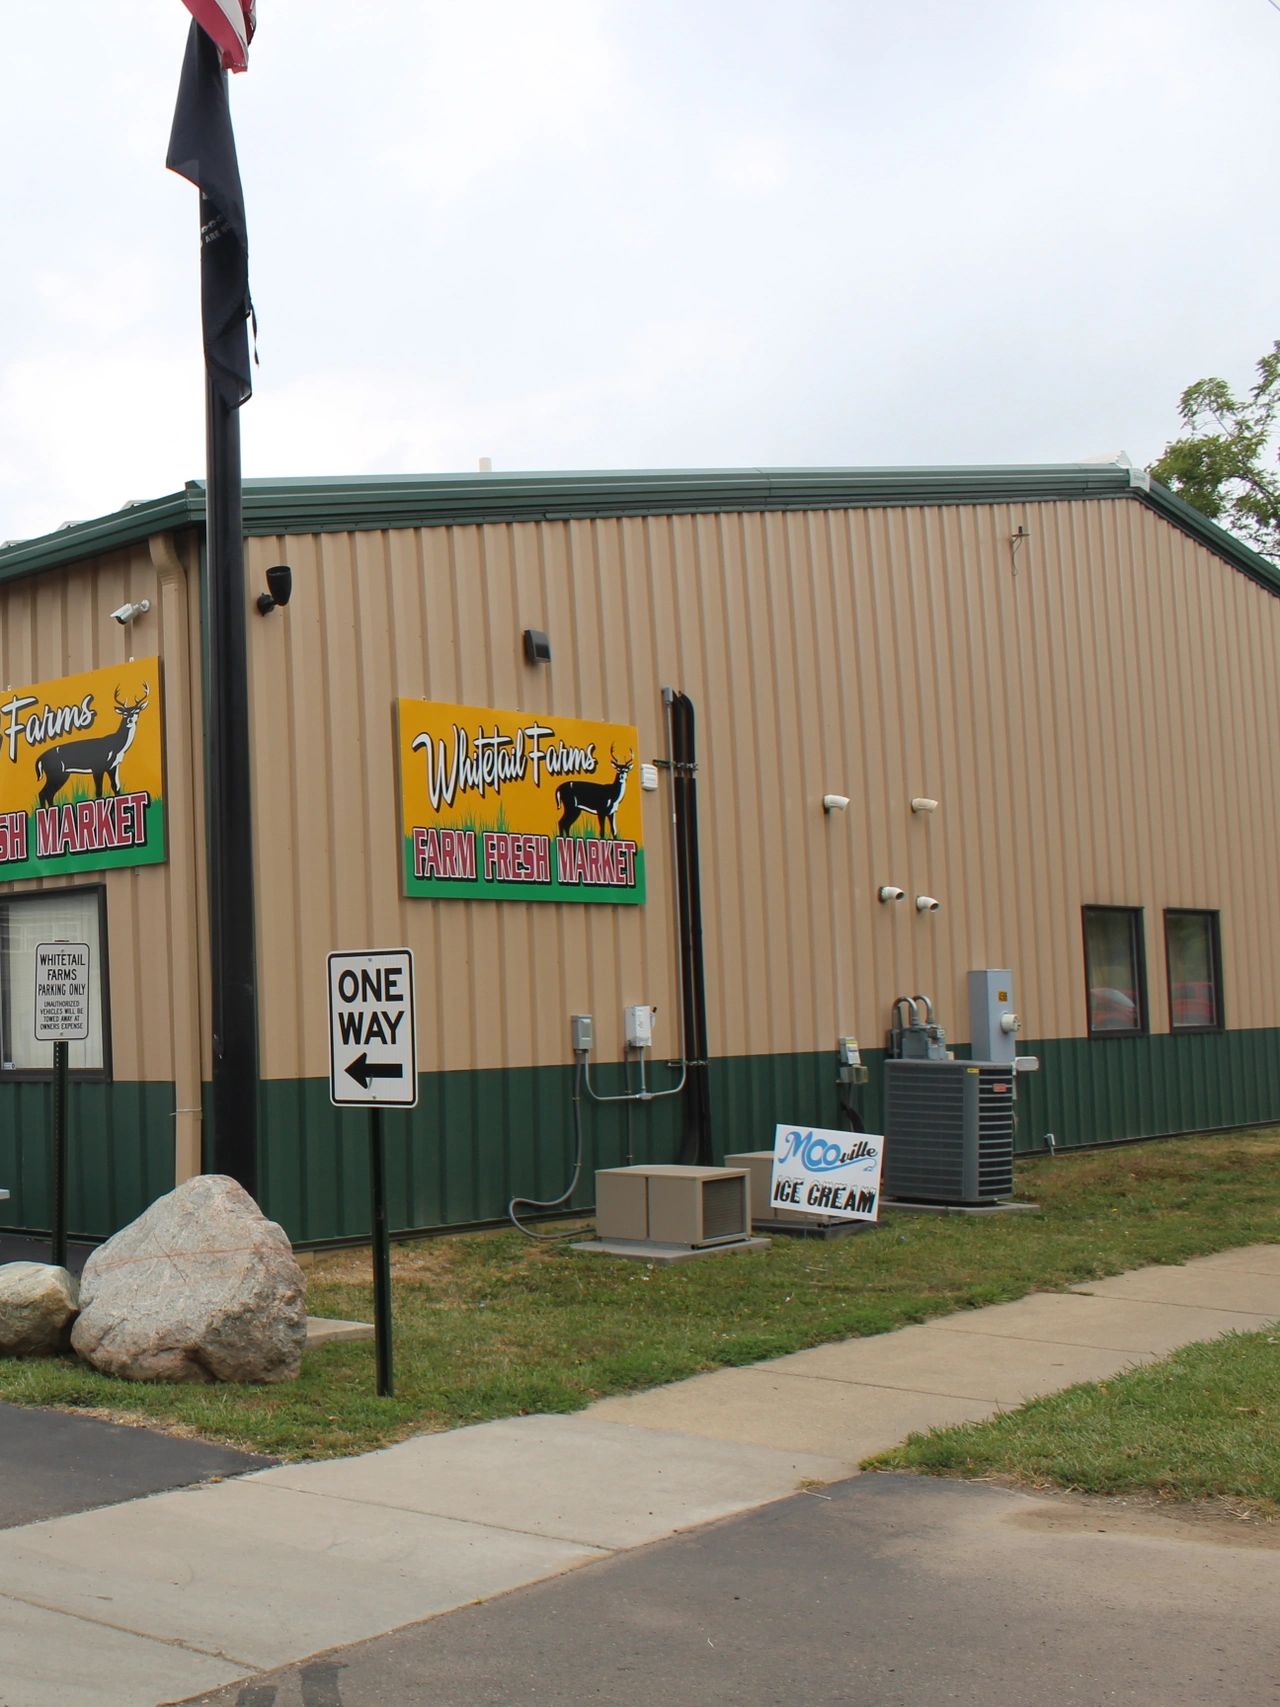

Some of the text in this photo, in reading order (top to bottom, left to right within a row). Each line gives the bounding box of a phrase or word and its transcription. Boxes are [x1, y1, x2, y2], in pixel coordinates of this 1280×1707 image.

[1, 694, 96, 763] Farms
[411, 721, 597, 812] Whitetail Farms
[36, 792, 150, 857] MARKET
[413, 827, 637, 886] FARM FRESH MARKET
[40, 954, 86, 966] WHITETAIL
[47, 969, 77, 981] FARMS
[38, 984, 86, 996] PARKING ONLY
[338, 967, 404, 1003] ONE
[43, 1015, 60, 1023] TOWED
[338, 1011, 405, 1045] WAY
[773, 1177, 877, 1214] ICE CREAM
